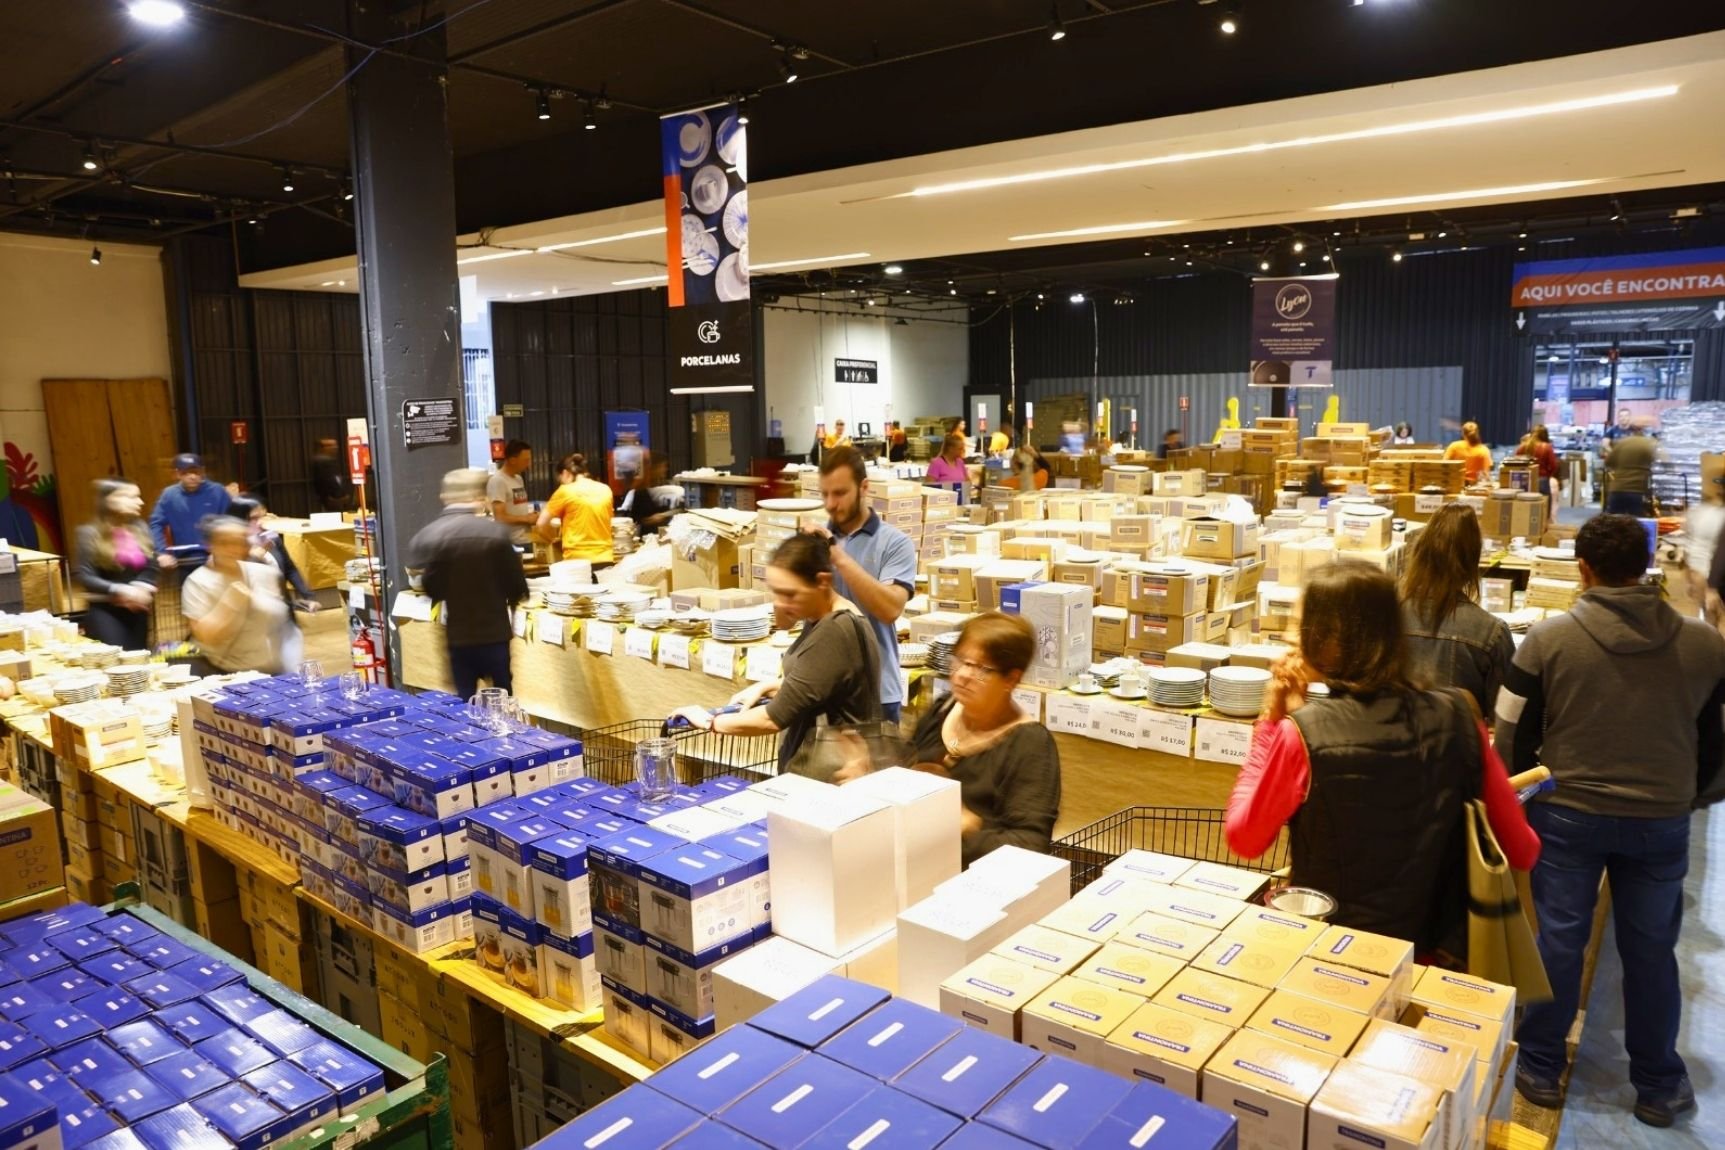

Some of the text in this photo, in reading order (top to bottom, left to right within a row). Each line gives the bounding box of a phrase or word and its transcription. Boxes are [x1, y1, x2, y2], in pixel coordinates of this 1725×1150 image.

[1520, 274, 1725, 301] AQUI VOCÊ ENCONTRA
[681, 353, 741, 367] PORCELANAS
[1305, 366, 1317, 379] T
[1317, 968, 1364, 985] TRAMONTINA
[1445, 977, 1491, 993] TRAMONTINA
[1181, 994, 1227, 1011] TRAMONTINA
[1276, 1019, 1326, 1039] TRAMONTINA
[1428, 1013, 1476, 1029] TRAMONTINA
[1136, 1032, 1185, 1051] TRAMONTINA
